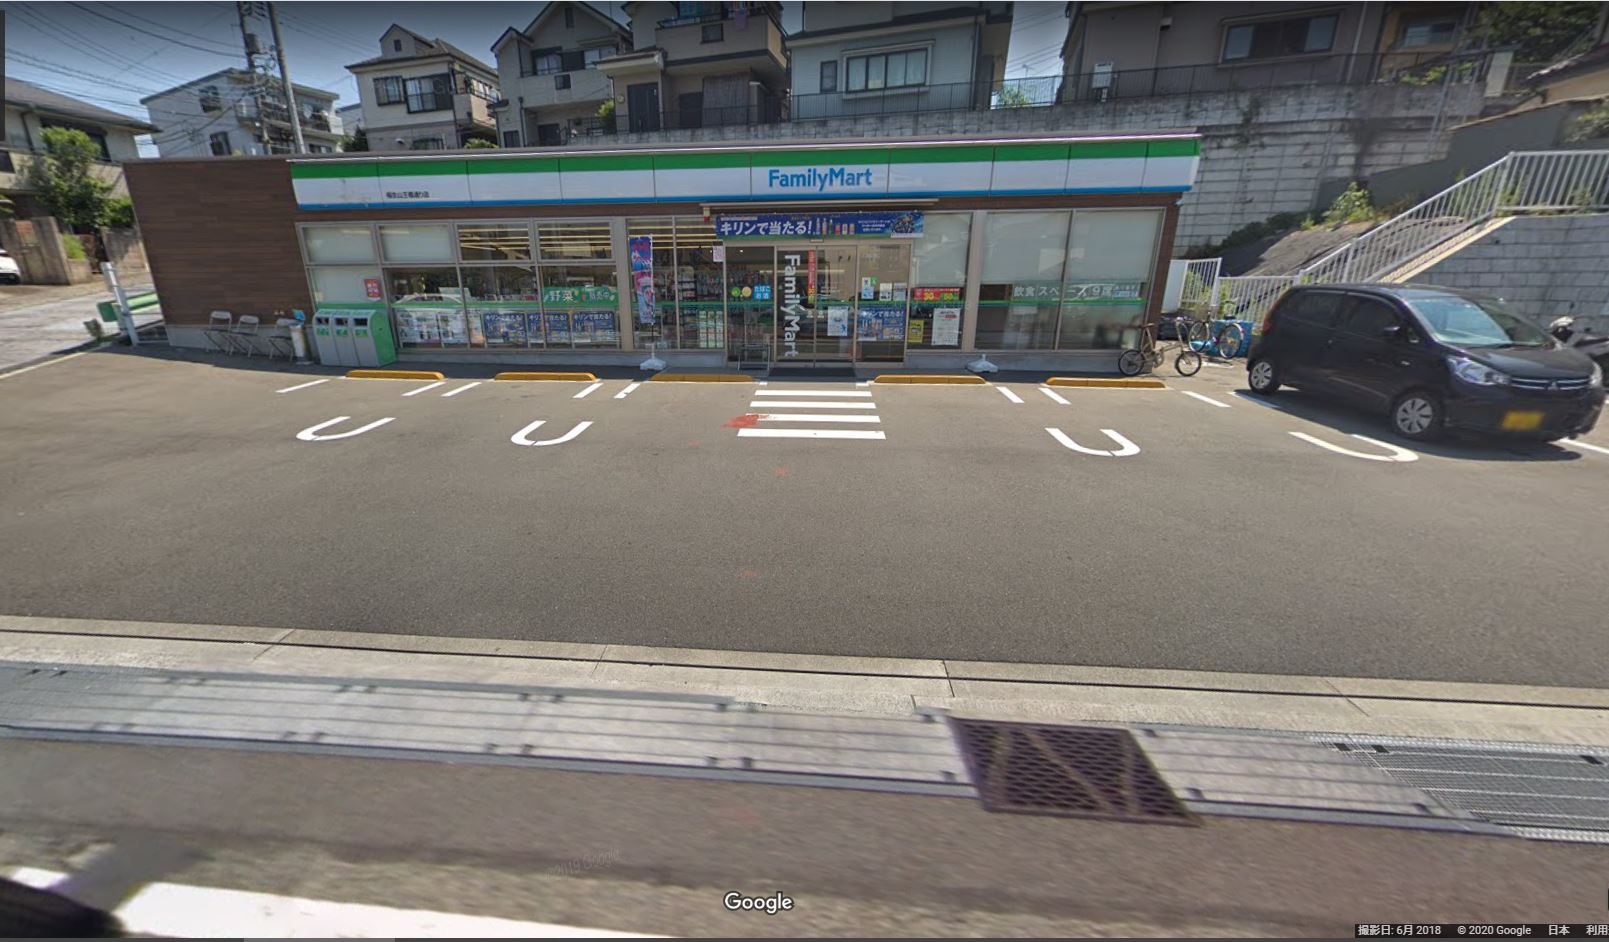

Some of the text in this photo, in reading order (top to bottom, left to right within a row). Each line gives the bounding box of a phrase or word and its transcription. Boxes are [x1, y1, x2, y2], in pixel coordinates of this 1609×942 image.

[769, 168, 872, 192] FamilyMart
[720, 220, 812, 236] キリンで当たる!
[549, 290, 574, 302] 野菜
[780, 254, 801, 357] FamilyMart
